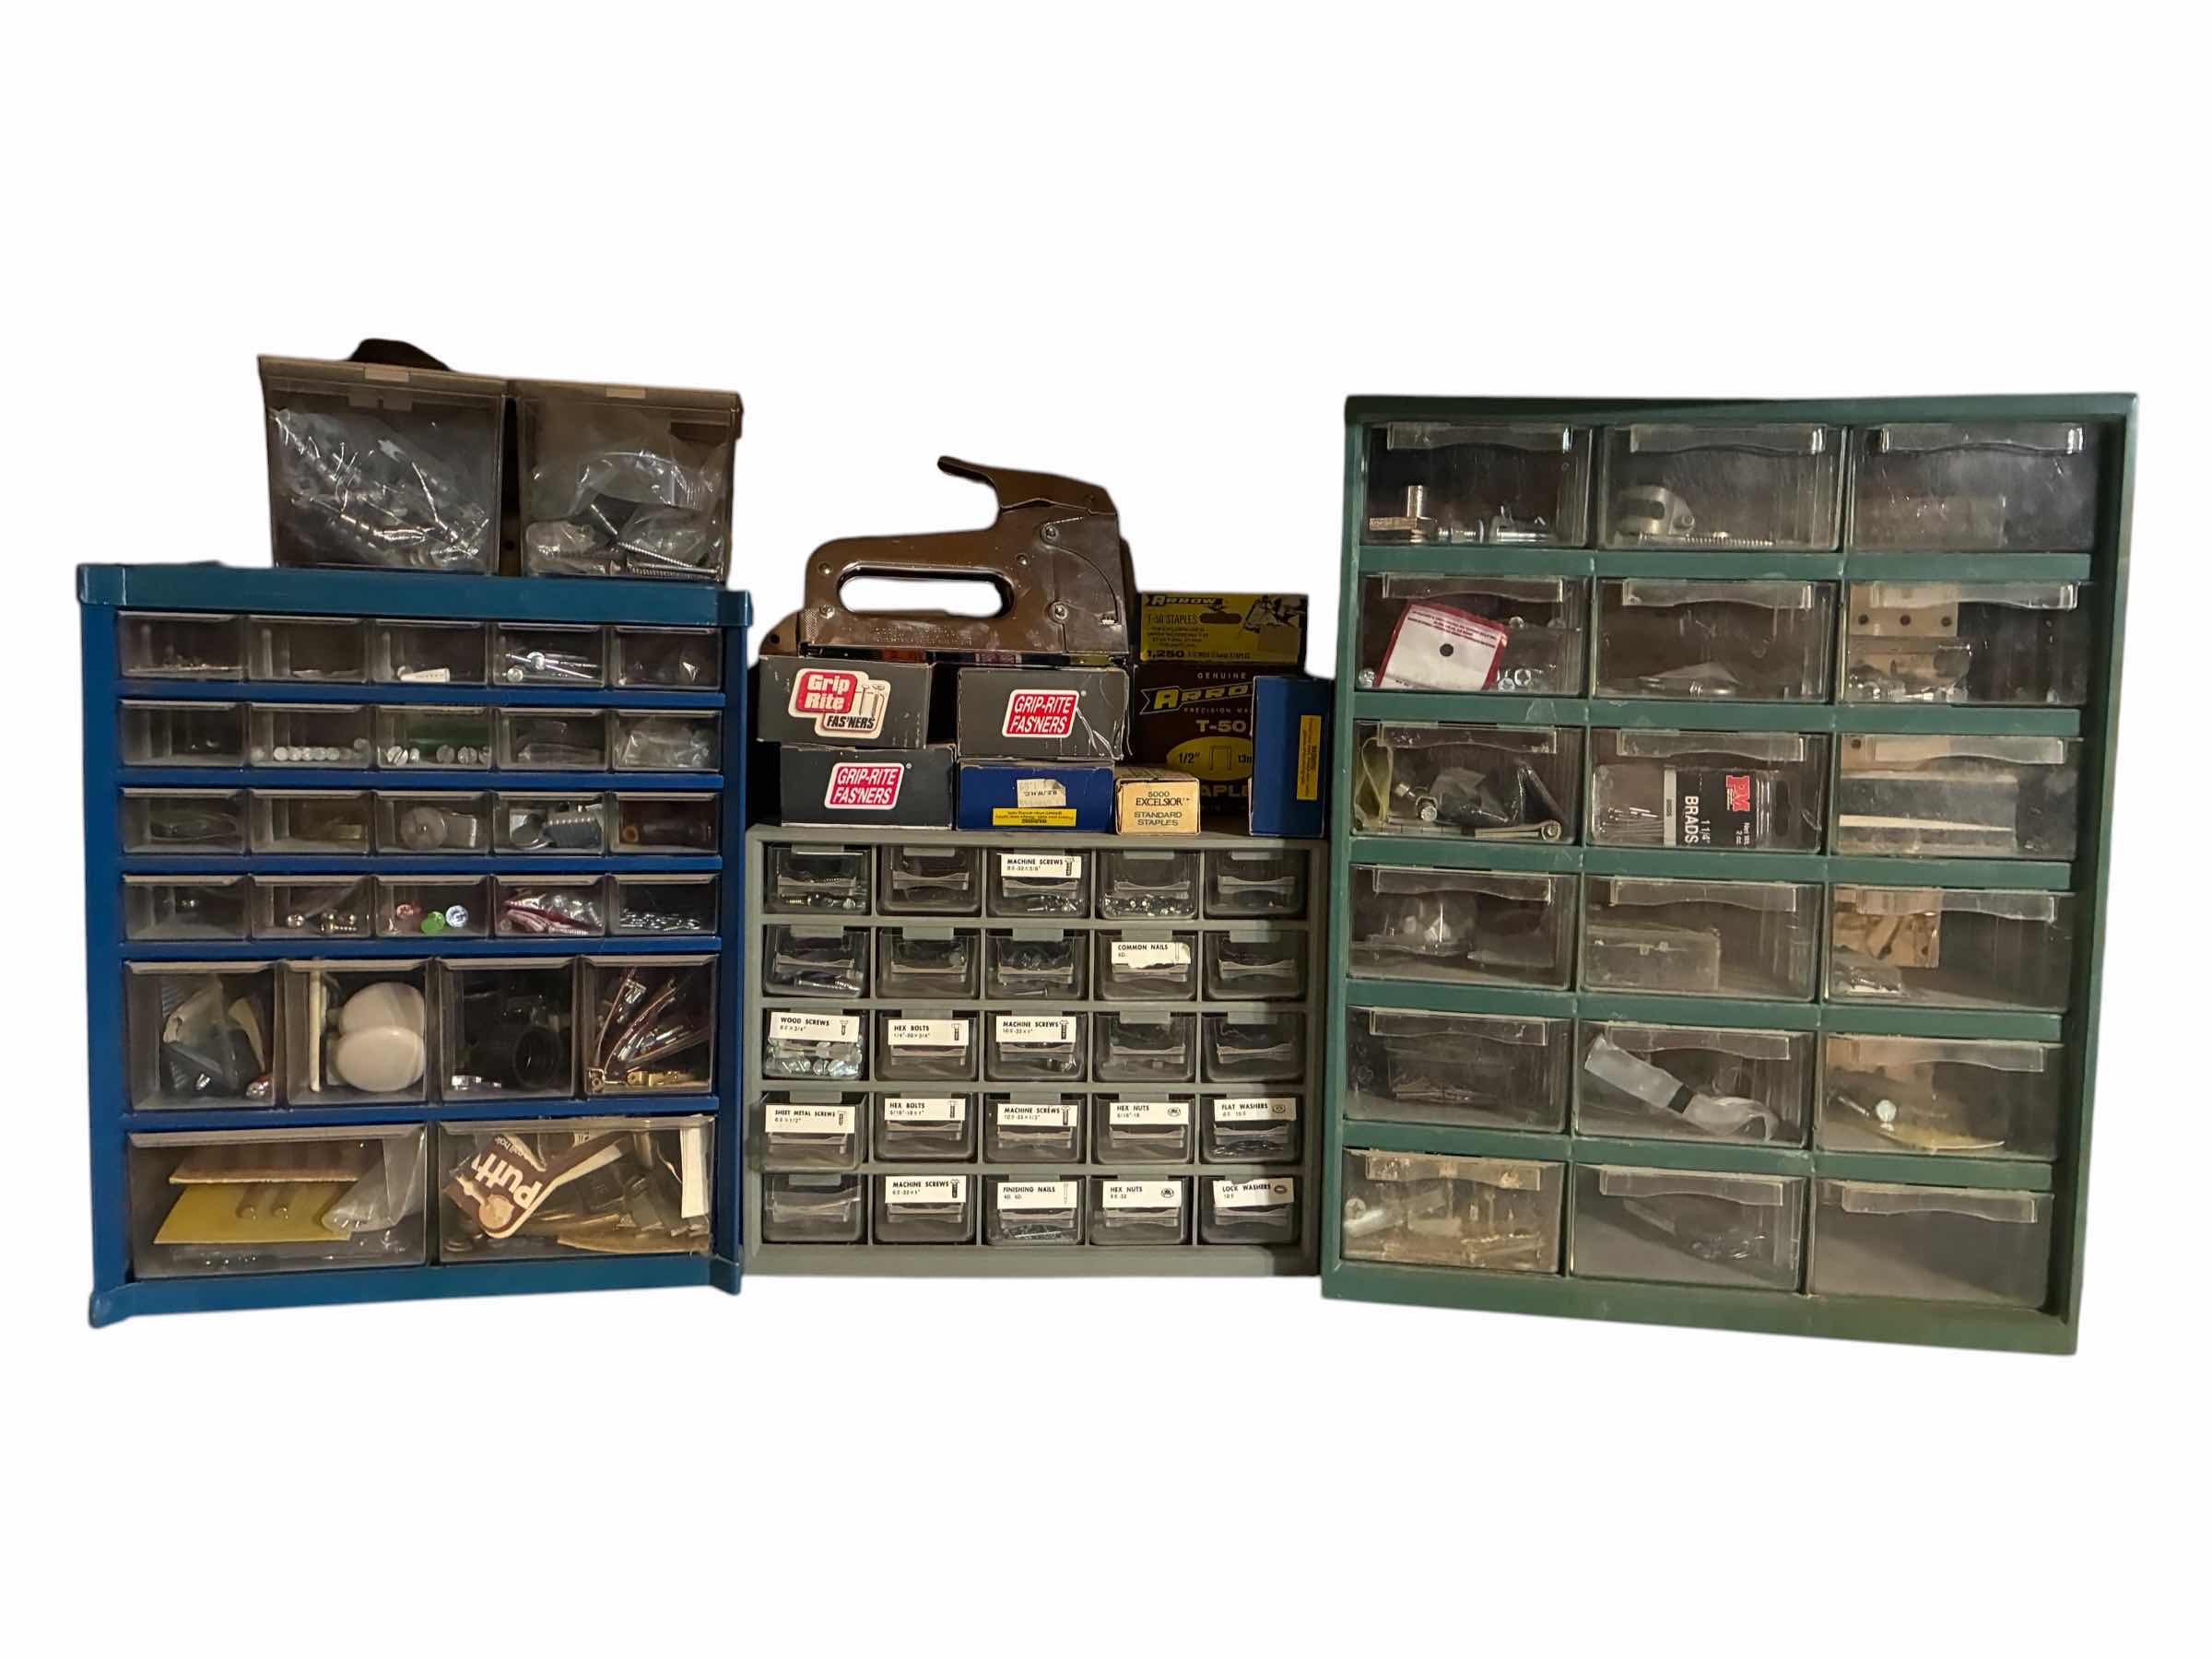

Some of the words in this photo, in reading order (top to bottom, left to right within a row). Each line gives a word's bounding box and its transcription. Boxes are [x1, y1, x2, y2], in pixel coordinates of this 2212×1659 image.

[1147, 650, 1184, 658] 1,250
[806, 674, 851, 694] Grip
[804, 692, 845, 711] Rite
[1013, 695, 1074, 713] GRIP-RITE
[1153, 684, 1250, 710] ARRO
[826, 715, 875, 729] FAS'NERS
[1010, 715, 1068, 734] FAS'NERS
[1195, 719, 1247, 733] T-50
[837, 767, 899, 785] GRIP-RITE
[832, 786, 893, 805] FAS'NERS
[1135, 797, 1183, 806] EXCELSIOR
[1134, 811, 1182, 819] STANDARD
[1136, 818, 1179, 827] STAPLES
[1685, 795, 1700, 844] BRADS
